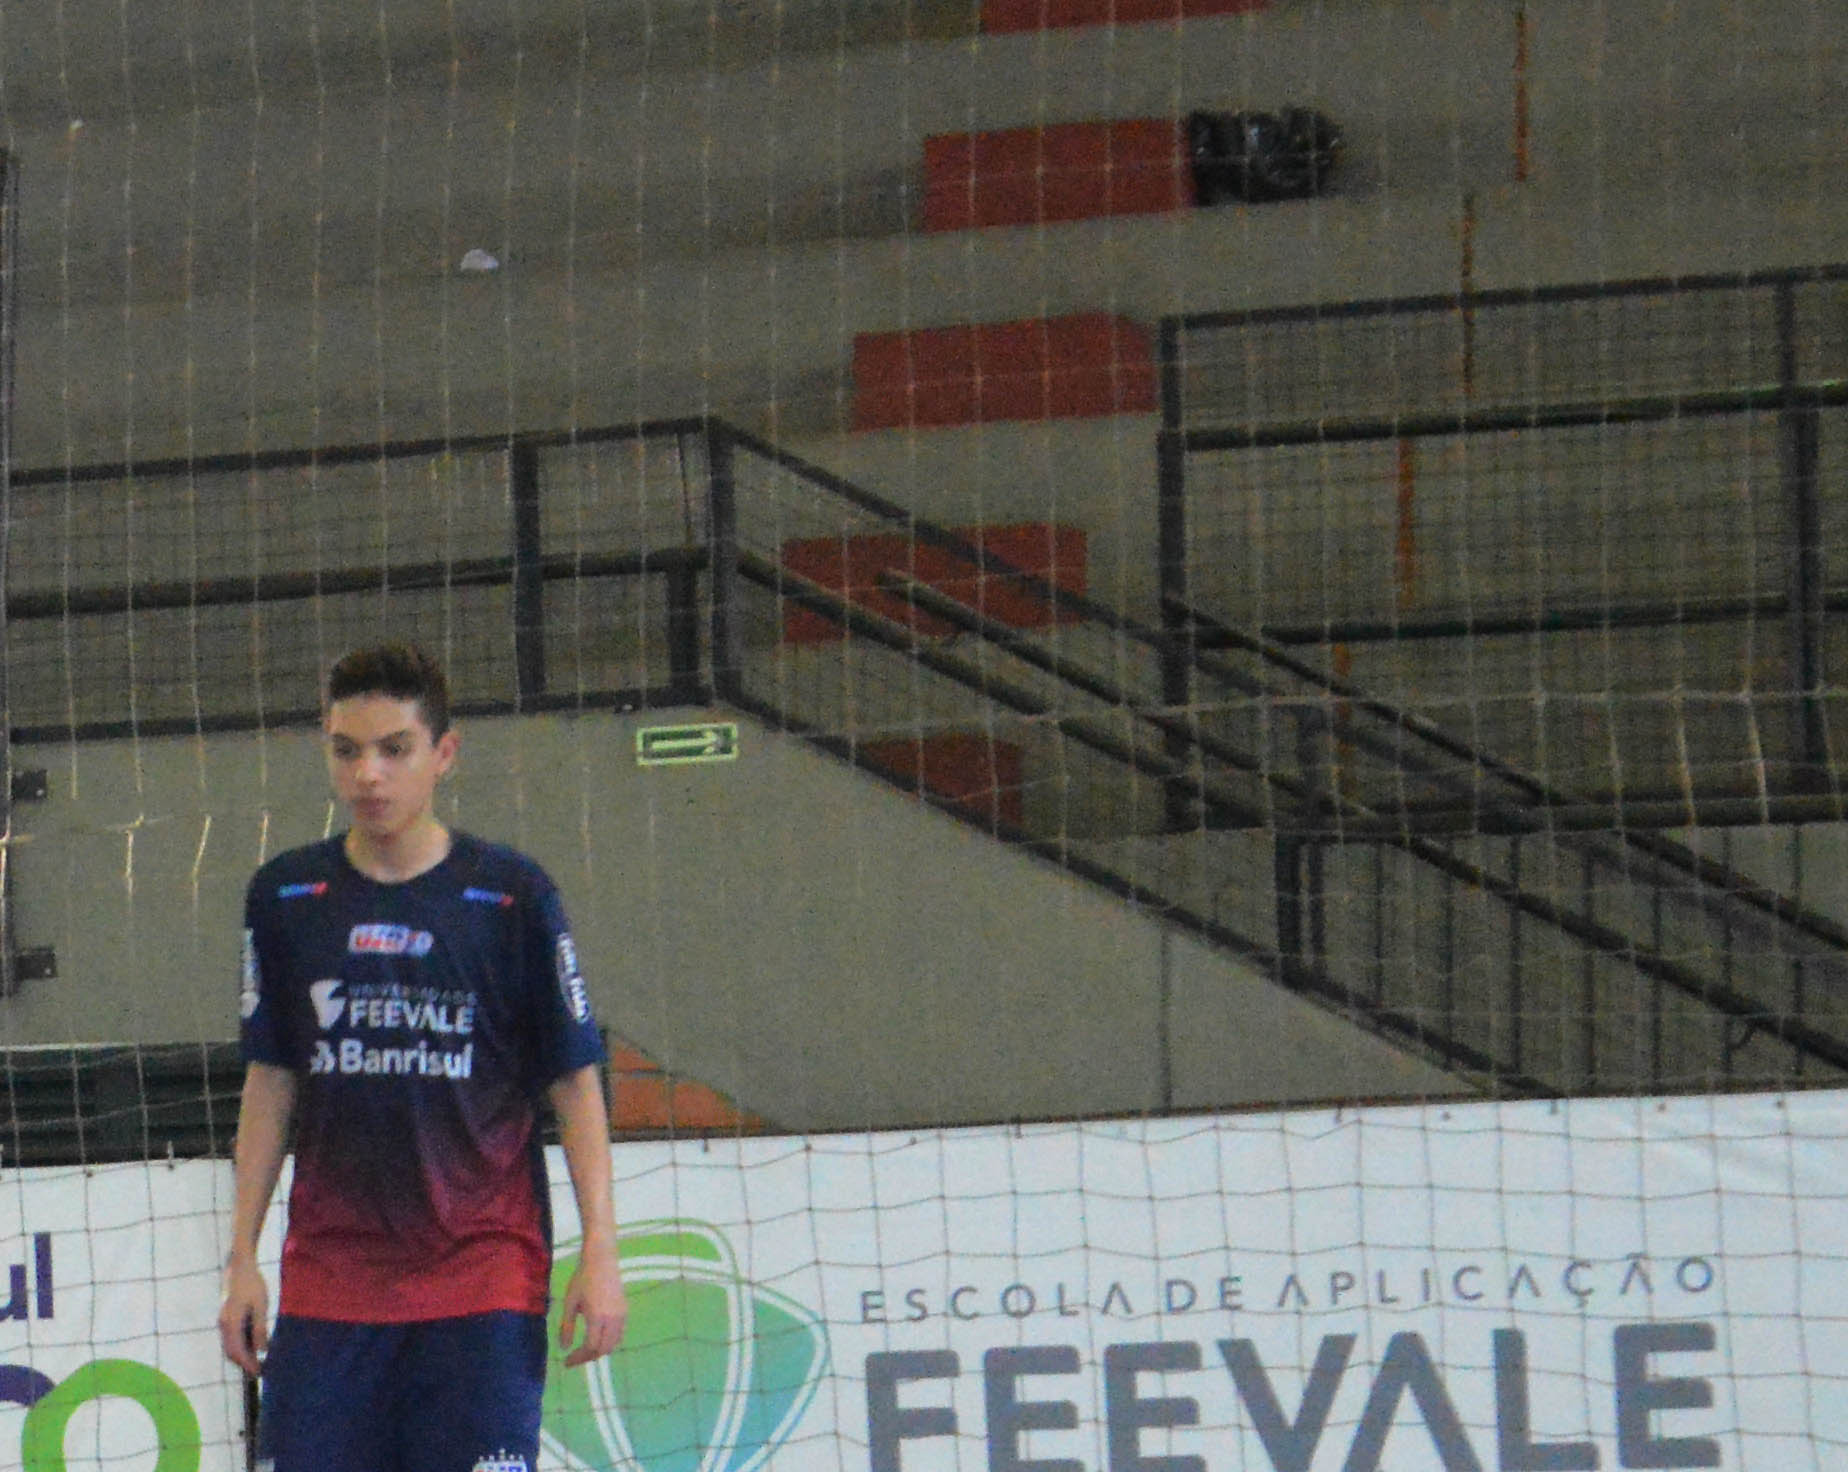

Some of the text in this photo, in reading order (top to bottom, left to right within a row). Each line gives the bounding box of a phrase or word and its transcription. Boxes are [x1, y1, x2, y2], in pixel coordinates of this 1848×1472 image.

[350, 998, 476, 1035] FEEVALE
[339, 1038, 474, 1079] Banrisul
[860, 1251, 1714, 1324] ESCOLA DE APLICAÇÃO
